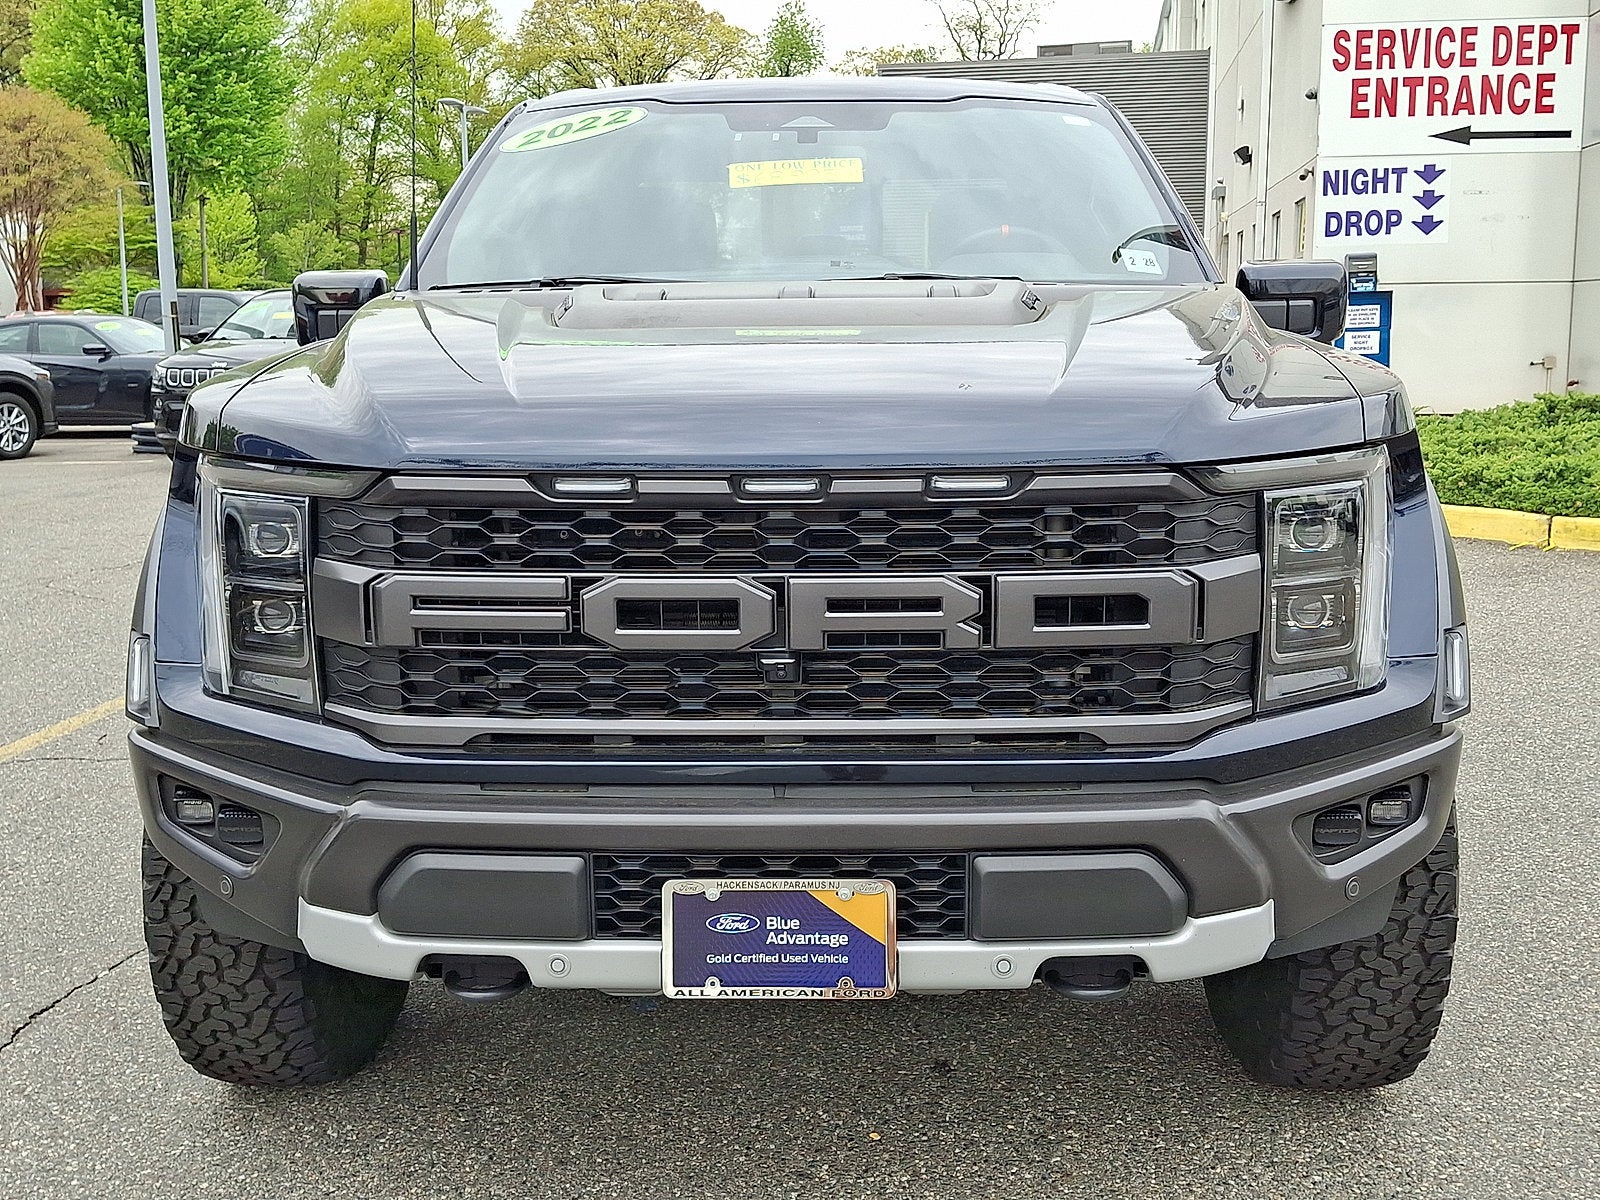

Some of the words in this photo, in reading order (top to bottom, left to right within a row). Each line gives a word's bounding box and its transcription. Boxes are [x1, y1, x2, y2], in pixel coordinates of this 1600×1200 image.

[1332, 27, 1478, 71] SERVICE
[1491, 23, 1580, 67] DEPT
[1350, 73, 1556, 118] ENTRANCE
[516, 109, 632, 148] 2022
[735, 163, 763, 172] ONE
[773, 160, 805, 170] LOW
[813, 159, 854, 169] PRICE
[1322, 167, 1408, 196] NIGHT
[1324, 209, 1403, 237] DROP
[1129, 256, 1136, 266] 2
[371, 570, 1201, 651] FORD
[1315, 827, 1360, 835] RAPTOR
[716, 881, 827, 890] HACKENSACK/PARAMUS
[828, 881, 841, 890] NJ
[715, 917, 750, 931] Ford
[766, 916, 800, 931] Blue
[766, 931, 849, 948] Advantage
[706, 954, 732, 964] Gold
[734, 953, 779, 964] Certified
[781, 954, 808, 964] Used
[810, 954, 849, 964] Vehicle
[673, 988, 711, 997] ALL
[717, 988, 824, 997] AMERICAN
[832, 988, 886, 998] FORD
